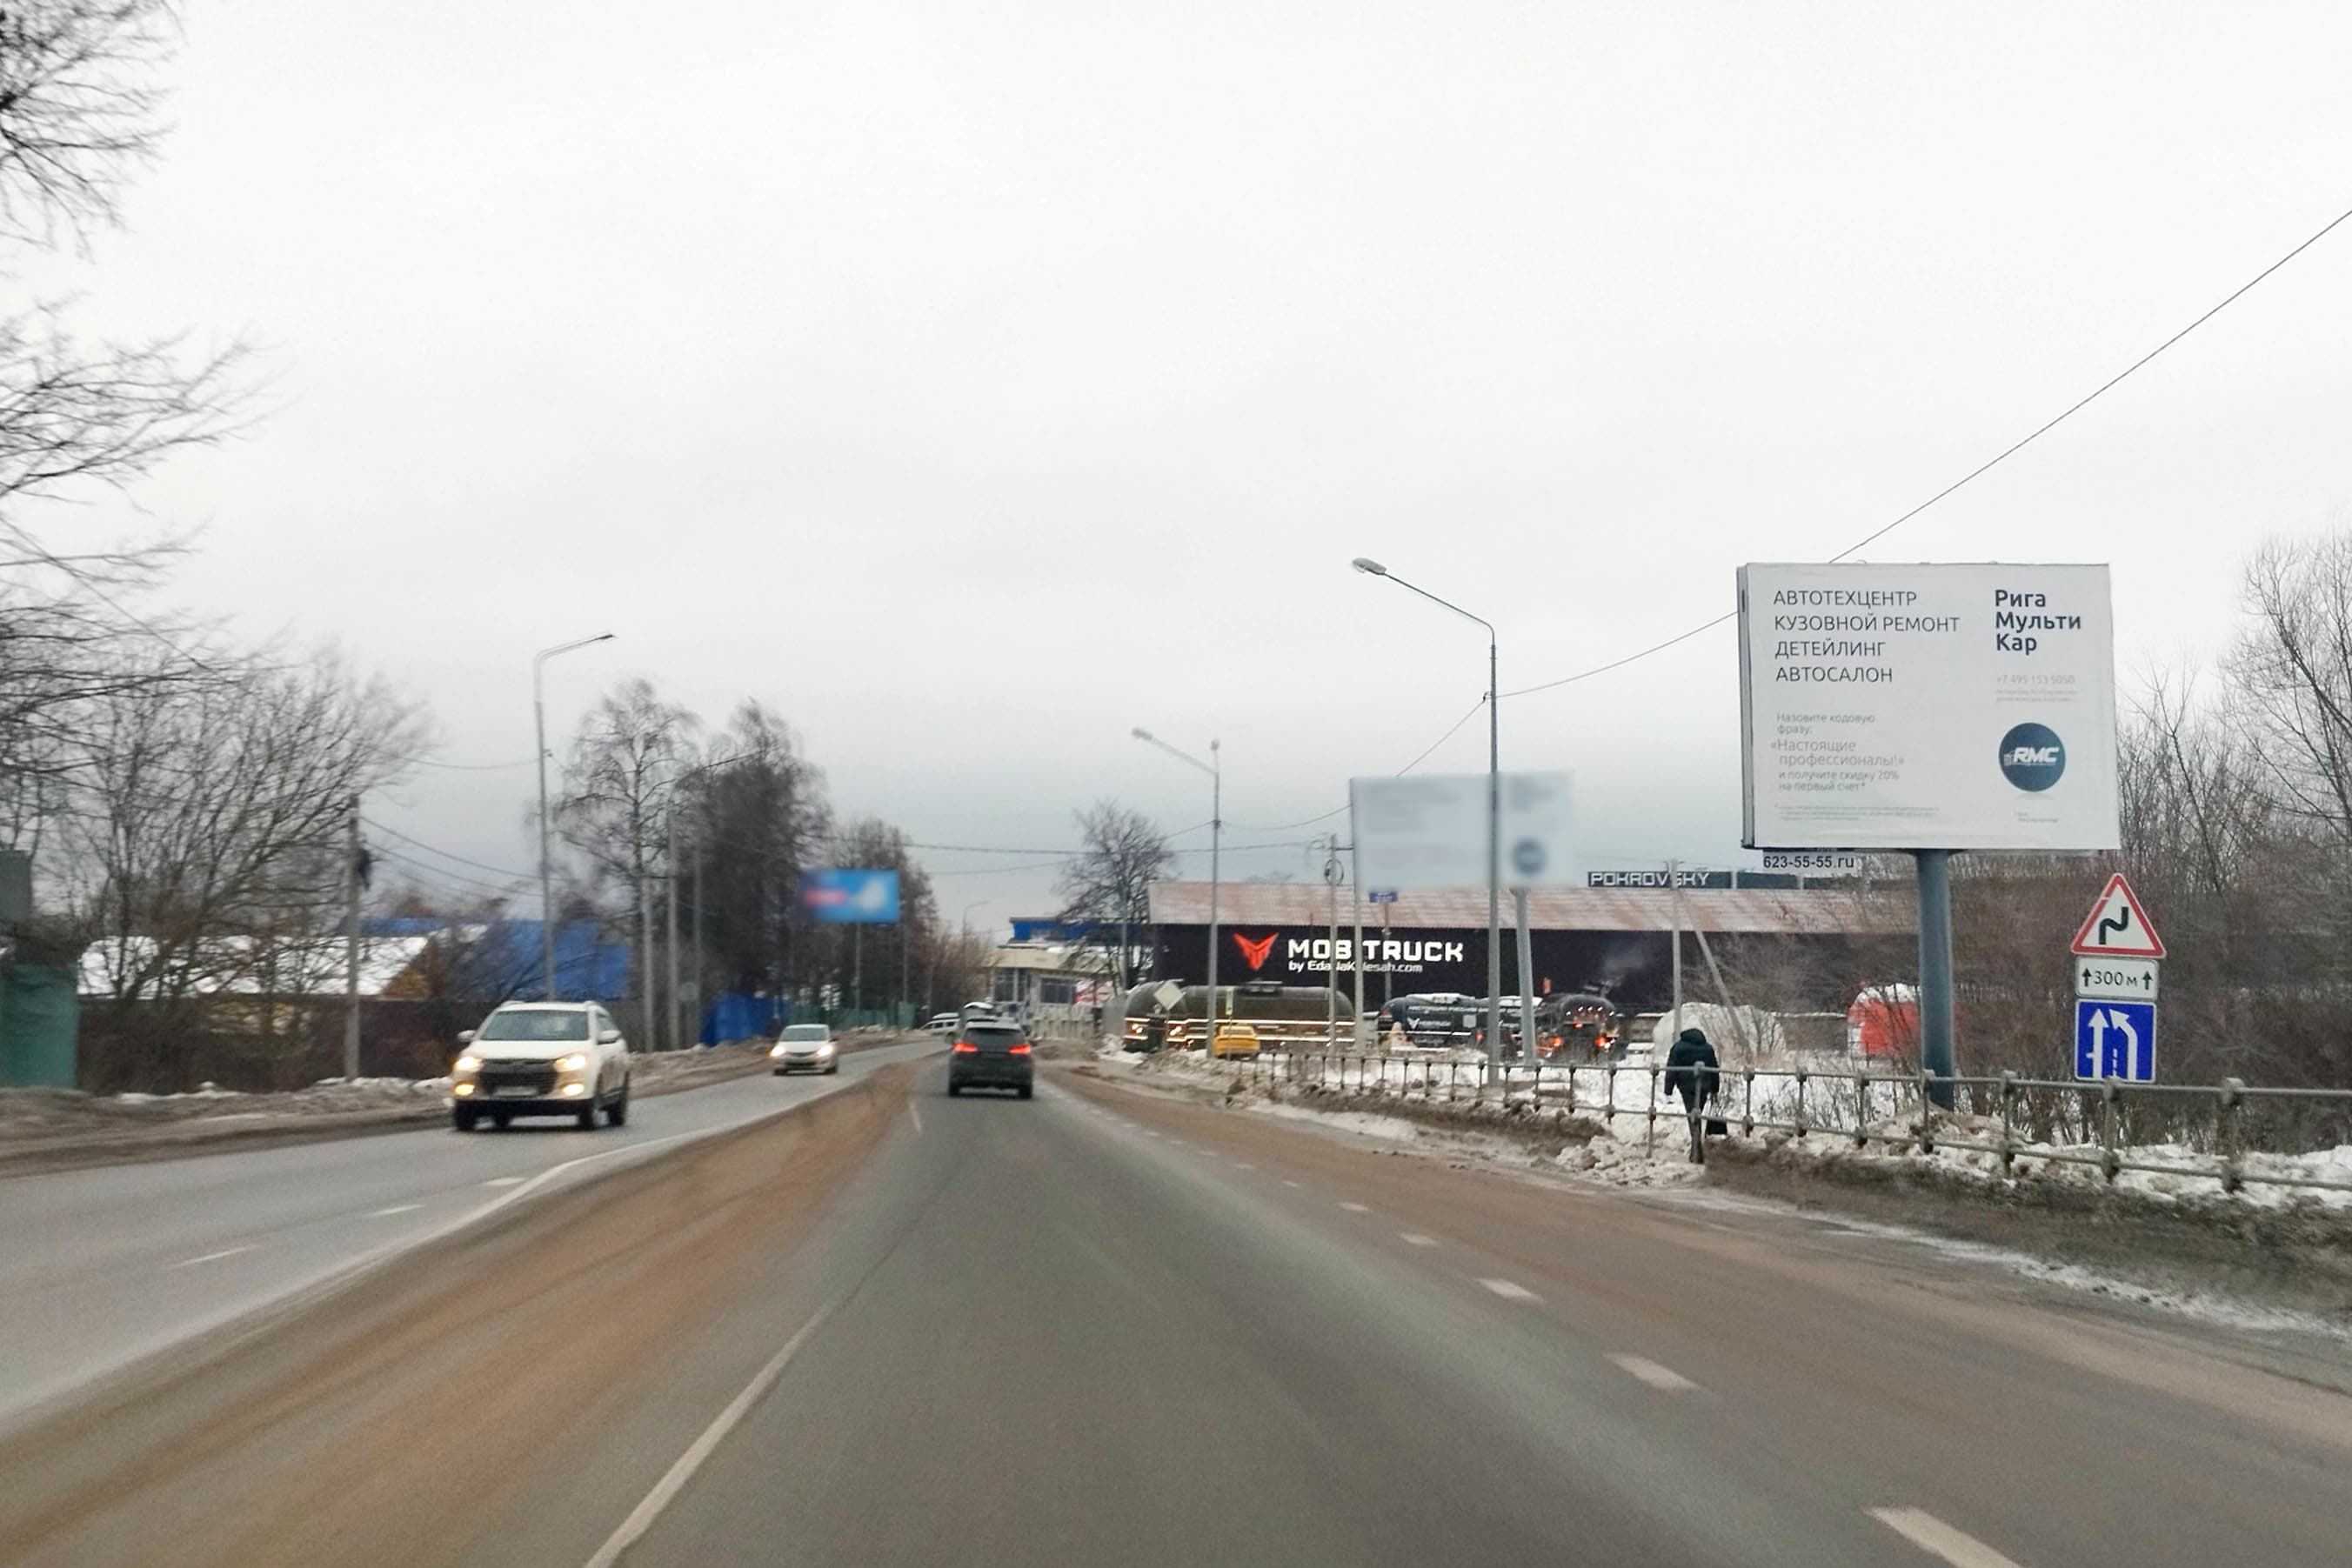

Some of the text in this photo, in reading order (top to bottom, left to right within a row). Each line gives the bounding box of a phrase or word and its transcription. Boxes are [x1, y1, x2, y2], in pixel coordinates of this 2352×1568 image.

[1773, 590, 1918, 610] АВТОТЕХЦЕНТР
[1995, 589, 2047, 608] Рига
[1774, 612, 1961, 632] КУЗОВНОЙ РЕМОНТ
[1995, 611, 2081, 633] Мульти
[1774, 637, 1887, 660] ДЕТЕЙЛИНГ
[1996, 632, 2038, 656] Кар
[1775, 666, 1894, 683] АВТОСАЛОН
[1776, 712, 1876, 724] Назовите кодовую
[1770, 738, 1857, 753] «Настоящие
[2014, 747, 2060, 763] RMC
[1787, 770, 1838, 781] получите
[1839, 771, 1875, 783] скидку
[1877, 770, 1901, 781] 20%
[1778, 783, 1792, 791] на
[1793, 781, 1835, 792] первый
[1763, 855, 1854, 869] 623-55-55.ru
[1590, 872, 1709, 886] POKROVSKY
[1362, 940, 1464, 963] TRUCK
[1288, 960, 1305, 973] by
[2093, 971, 2123, 986] 300
